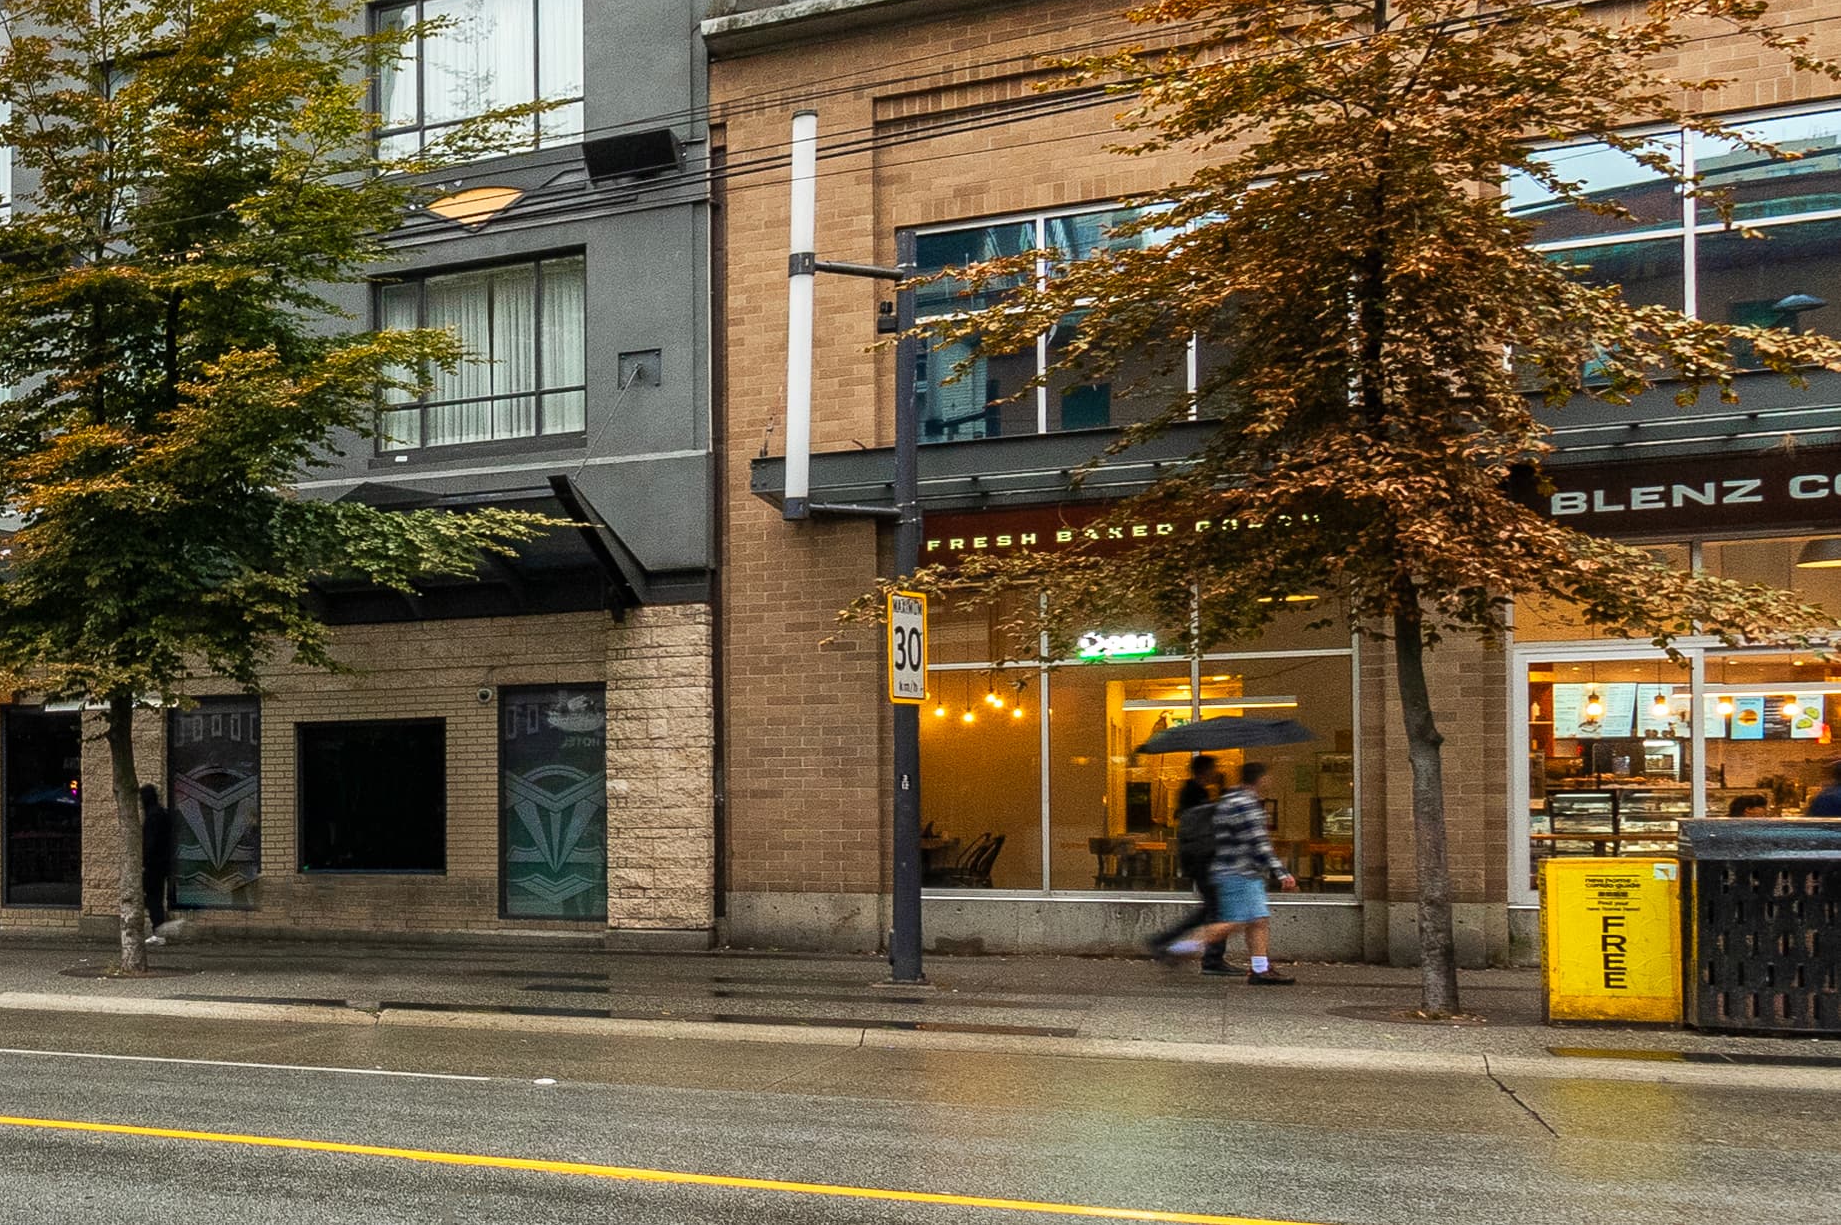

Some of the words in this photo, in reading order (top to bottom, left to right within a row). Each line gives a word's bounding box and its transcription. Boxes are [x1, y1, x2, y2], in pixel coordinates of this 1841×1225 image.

[1551, 479, 1763, 515] BLENZ
[1788, 474, 1841, 500] C
[927, 533, 1037, 552] FRESH
[1056, 523, 1173, 543] BAKED
[894, 625, 921, 672] 30
[899, 680, 918, 692] km/h
[1601, 916, 1628, 989] FREE
